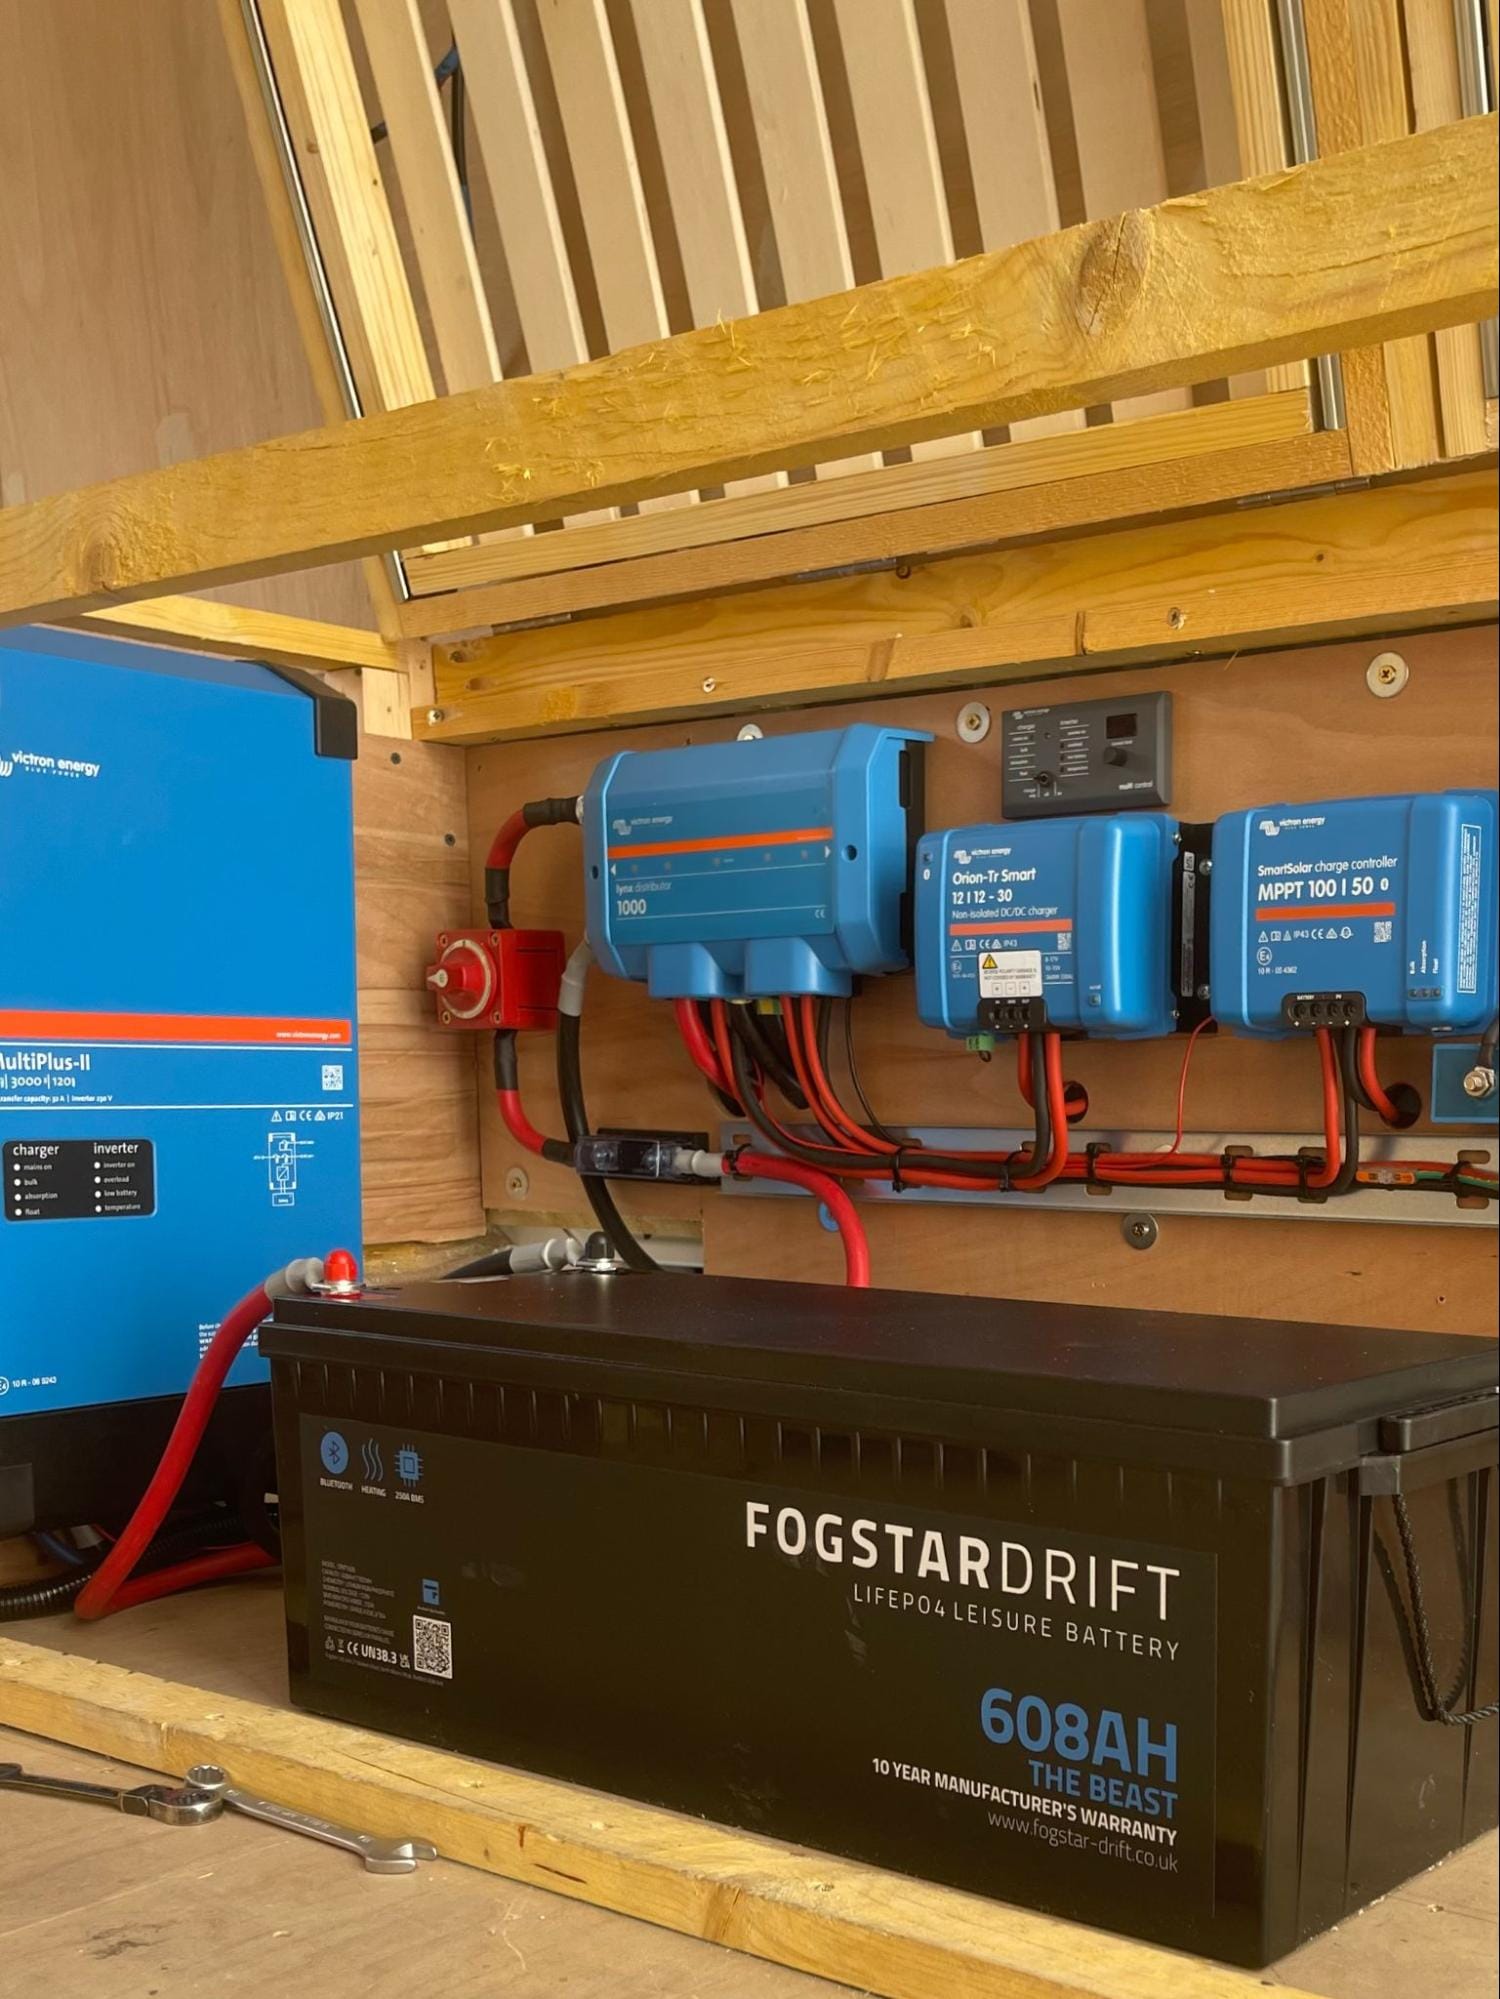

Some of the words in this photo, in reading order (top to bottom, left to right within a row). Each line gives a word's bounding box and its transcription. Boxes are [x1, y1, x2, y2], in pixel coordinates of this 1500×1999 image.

[11, 750, 55, 768] victron
[57, 759, 100, 777] energy
[1279, 818, 1301, 827] victron
[1302, 817, 1325, 826] energy
[1257, 861, 1312, 876] SmartSolar
[1314, 860, 1348, 874] charge
[1351, 855, 1398, 870] controller
[952, 870, 998, 885] Orion-Tr
[1001, 867, 1036, 882] Smart
[635, 881, 672, 892] distributor
[1258, 881, 1304, 901] MPPT
[1308, 878, 1337, 898] 100
[1351, 876, 1374, 896] 50
[952, 892, 964, 905] 12
[974, 890, 986, 903] 12
[997, 889, 1013, 903] 30
[617, 899, 647, 915] 1000
[952, 909, 999, 919] Non-isolated
[1000, 906, 1026, 917] DC/DC
[1028, 906, 1058, 917] charger
[13, 1143, 59, 1159] charger
[93, 1142, 139, 1154] inverter
[23, 1163, 42, 1171] mains
[25, 1192, 58, 1201] absorption
[104, 1189, 114, 1197] low
[116, 1189, 137, 1198] battery
[105, 1203, 141, 1212] temperature
[320, 1478, 353, 1490] BLUETOOTH
[361, 1486, 386, 1497] HEATING
[854, 1583, 945, 1617] LIFEPO4
[954, 1601, 1052, 1638] LEISURE
[1066, 1622, 1179, 1661] BATTERY
[361, 1644, 397, 1664] UN38.3
[981, 1688, 1177, 1783] 608AH
[1029, 1759, 1081, 1797] THE
[1089, 1774, 1178, 1819] BEAST
[872, 1757, 889, 1775] 10
[893, 1762, 931, 1786] YEAR
[934, 1772, 1077, 1822] MANUFACTURER'S
[1080, 1807, 1178, 1846] WARRANTY
[988, 1812, 1178, 1872] www.fogstar-drift.co.uk
